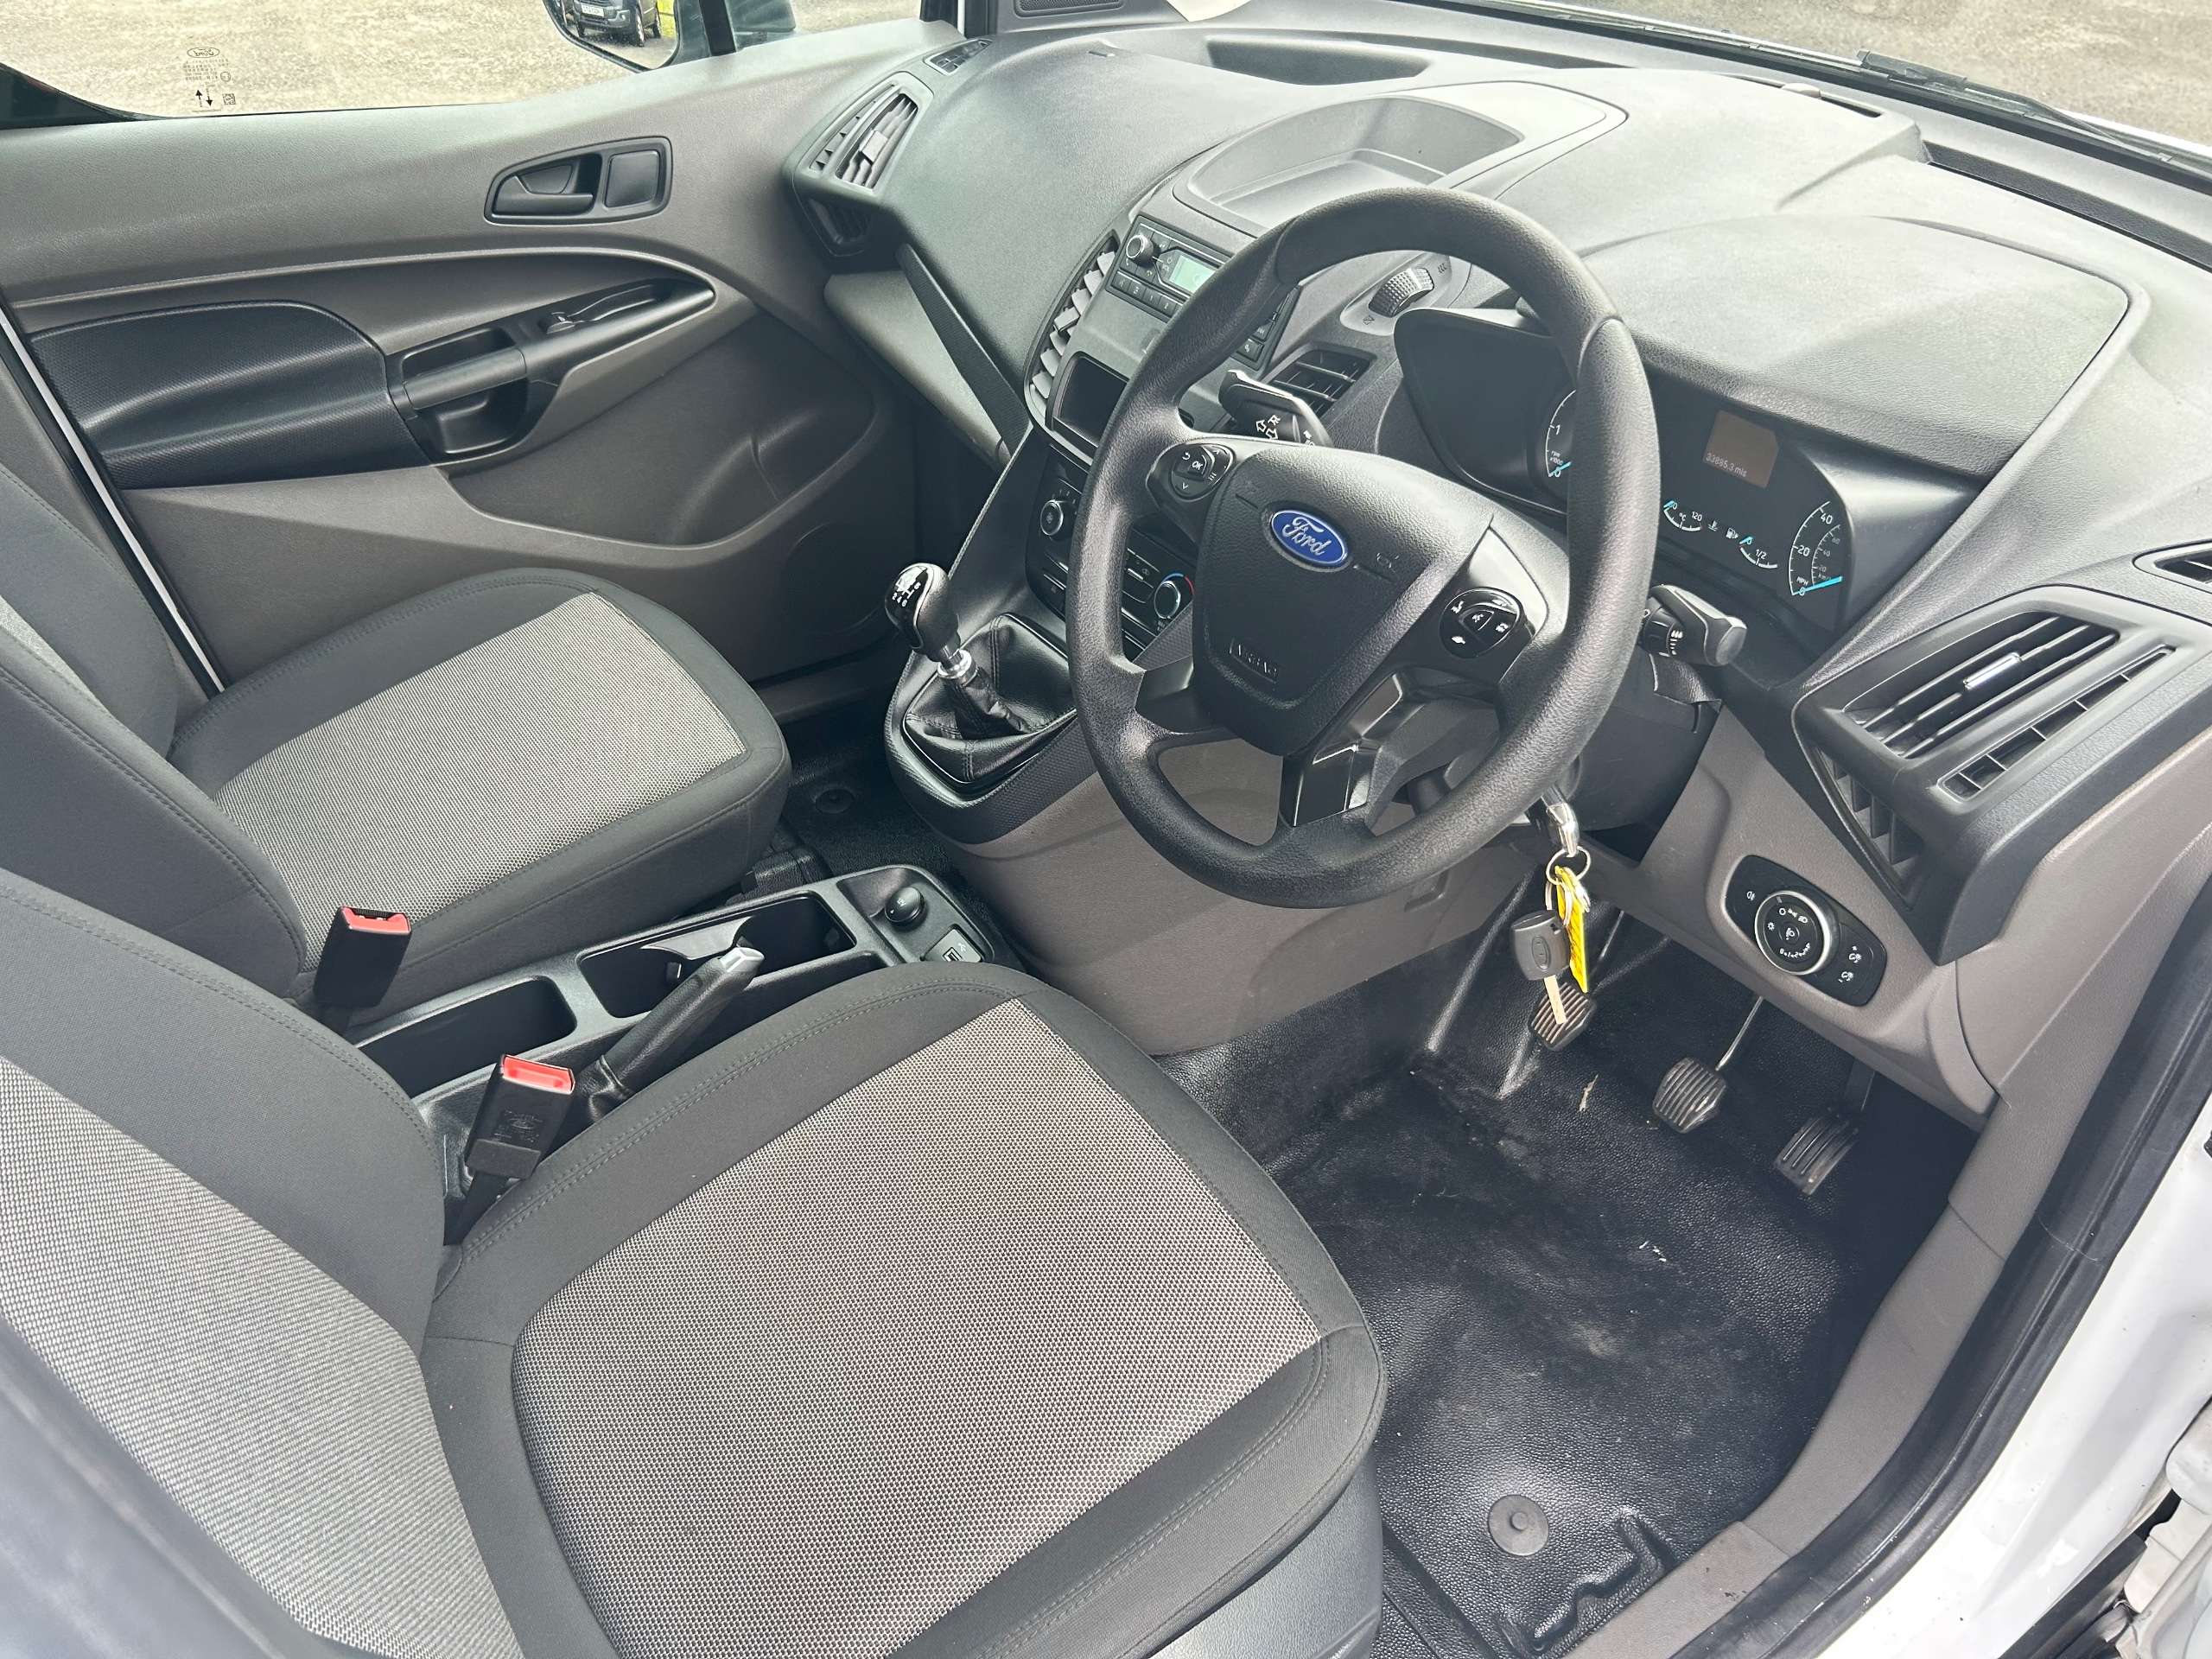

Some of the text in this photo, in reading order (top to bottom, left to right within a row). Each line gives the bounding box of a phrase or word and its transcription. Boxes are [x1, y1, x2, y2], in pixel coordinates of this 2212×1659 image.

[1268, 415, 1281, 425] R
[1555, 424, 1560, 435] 1
[1192, 461, 1204, 470] OK
[1691, 511, 1702, 522] 120
[1820, 512, 1833, 524] 40
[1282, 516, 1332, 556] Ford
[1756, 549, 1767, 560] 1/2
[1798, 544, 1810, 557] 20
[1796, 576, 1808, 586] MPH
